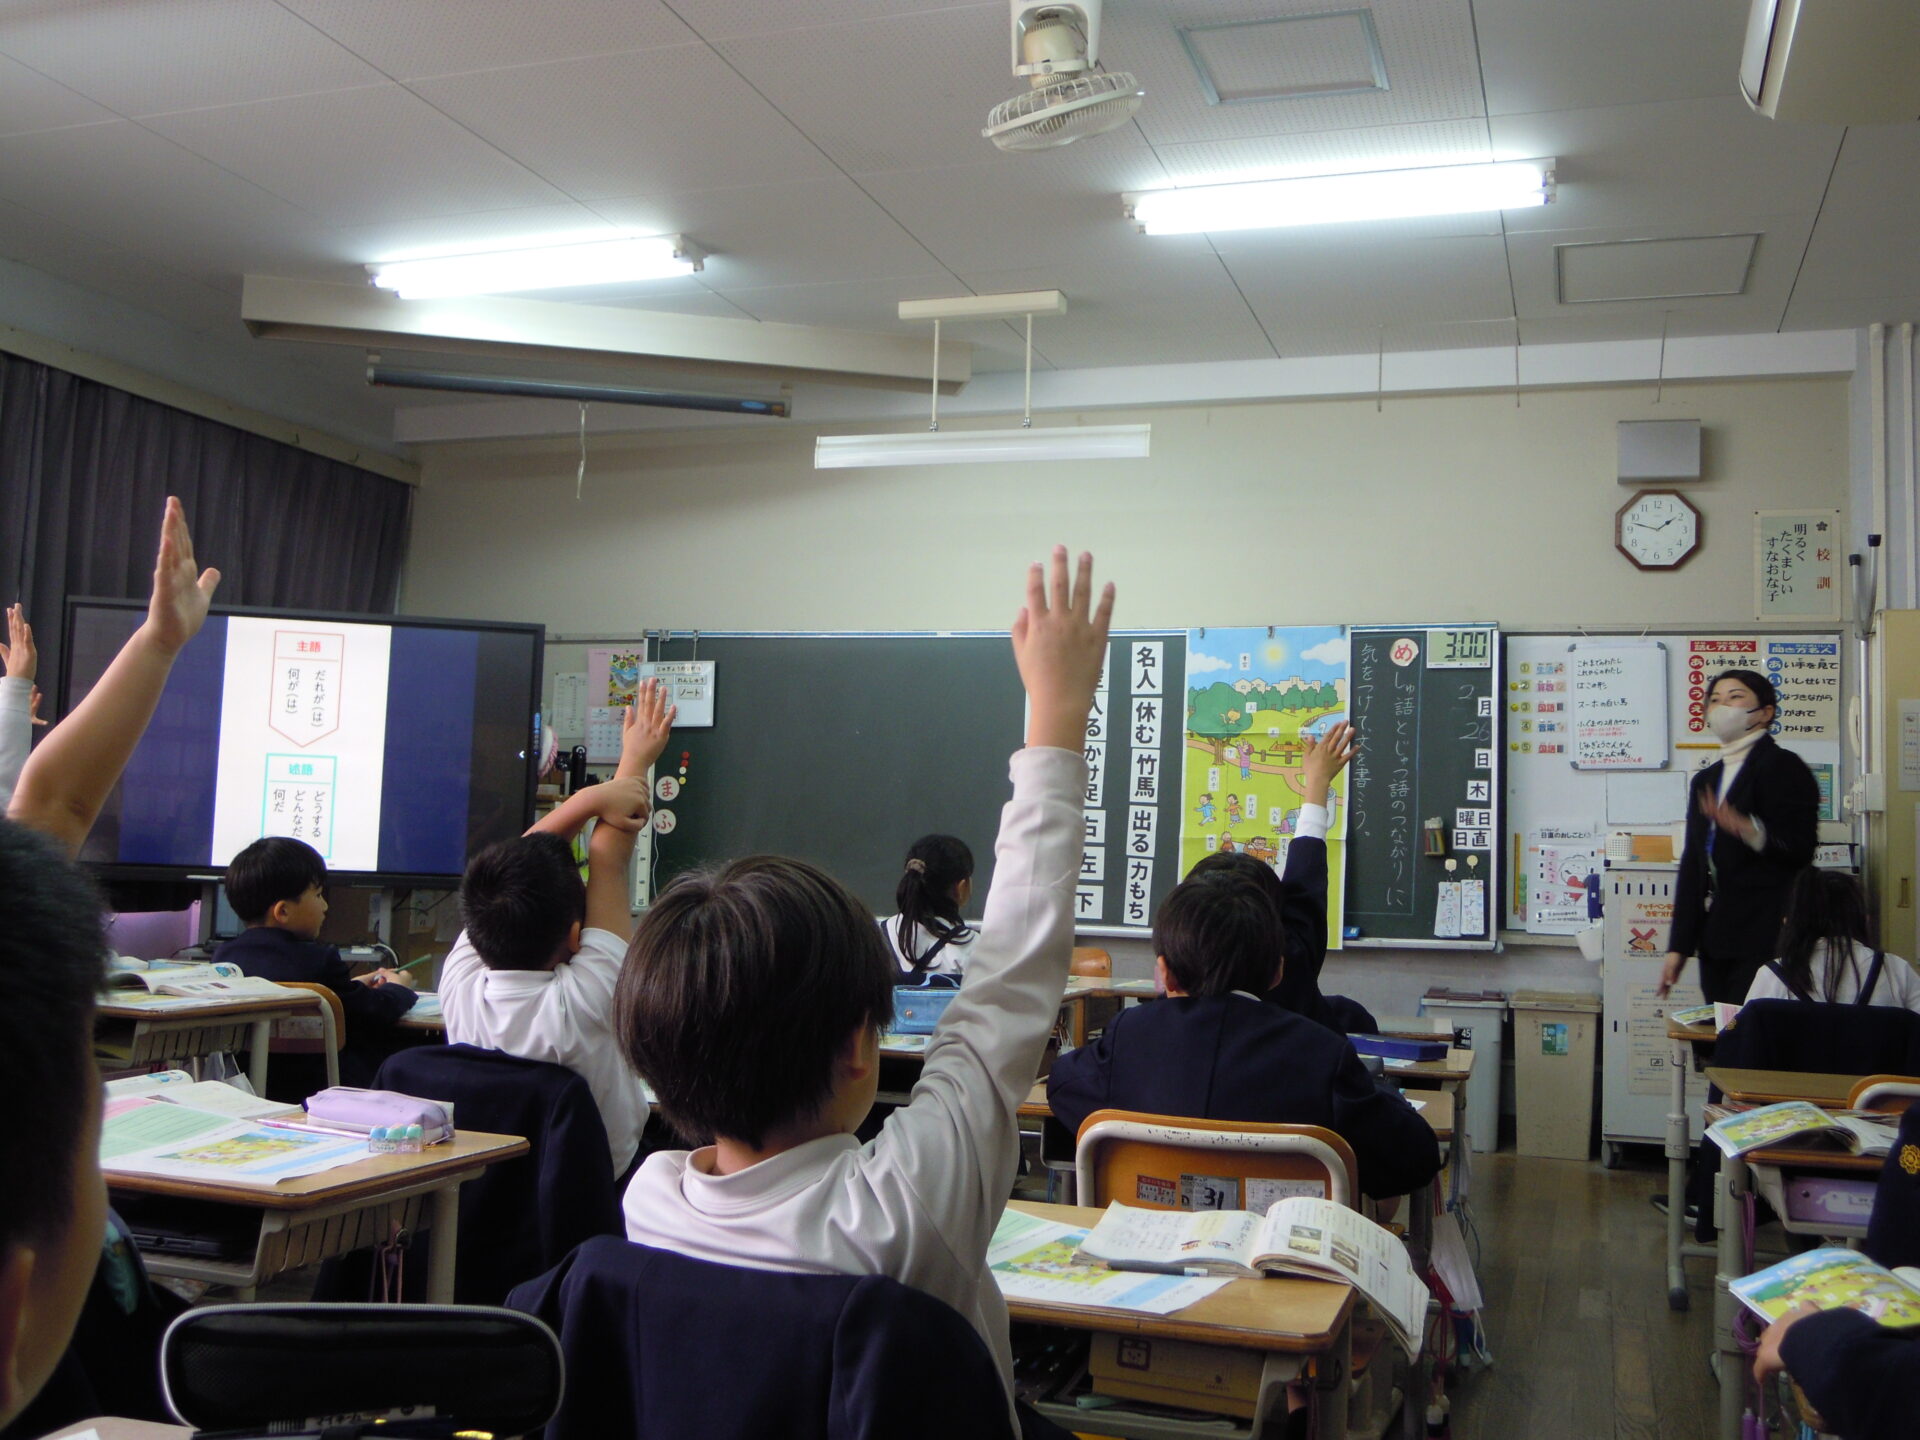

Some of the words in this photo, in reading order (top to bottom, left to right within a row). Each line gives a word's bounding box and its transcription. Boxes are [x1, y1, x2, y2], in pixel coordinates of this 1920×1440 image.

[1641, 504, 1648, 512] 11
[1654, 500, 1662, 509] 12
[1669, 504, 1673, 512] 1
[1627, 526, 1633, 534] 9
[1682, 526, 1688, 534] 3
[1631, 539, 1637, 547] 8
[1676, 539, 1682, 547] 4
[1794, 523, 1807, 562] 明るく
[1653, 552, 1660, 560] 6
[1668, 548, 1673, 557] 5
[1766, 537, 1780, 602] すなおな子
[1780, 530, 1793, 594] たくましい
[1816, 547, 1831, 590] 校訓
[296, 640, 321, 653] 主語
[1394, 644, 1413, 661] め
[1444, 631, 1488, 659] 3:00
[1136, 646, 1156, 689] 名人
[680, 688, 700, 697] ノート
[1458, 684, 1475, 700] 2
[1480, 700, 1491, 715] 月
[1135, 701, 1156, 745] 休む
[1477, 753, 1488, 767] 日
[1135, 754, 1157, 798] 竹馬
[661, 780, 673, 797] ま
[1470, 782, 1485, 798] 木
[273, 789, 286, 813] 何だ
[292, 789, 306, 838] どんなだ
[312, 790, 325, 838] どうする
[655, 813, 673, 831] ふ
[1458, 810, 1490, 826] 曜日
[1132, 810, 1152, 853] 出る
[1455, 830, 1488, 847] 日直
[1081, 852, 1097, 874] 左
[1129, 861, 1148, 920] 力もち
[1076, 892, 1094, 913] 下
[1461, 1028, 1471, 1038] 45
[1203, 1186, 1225, 1210] 31
